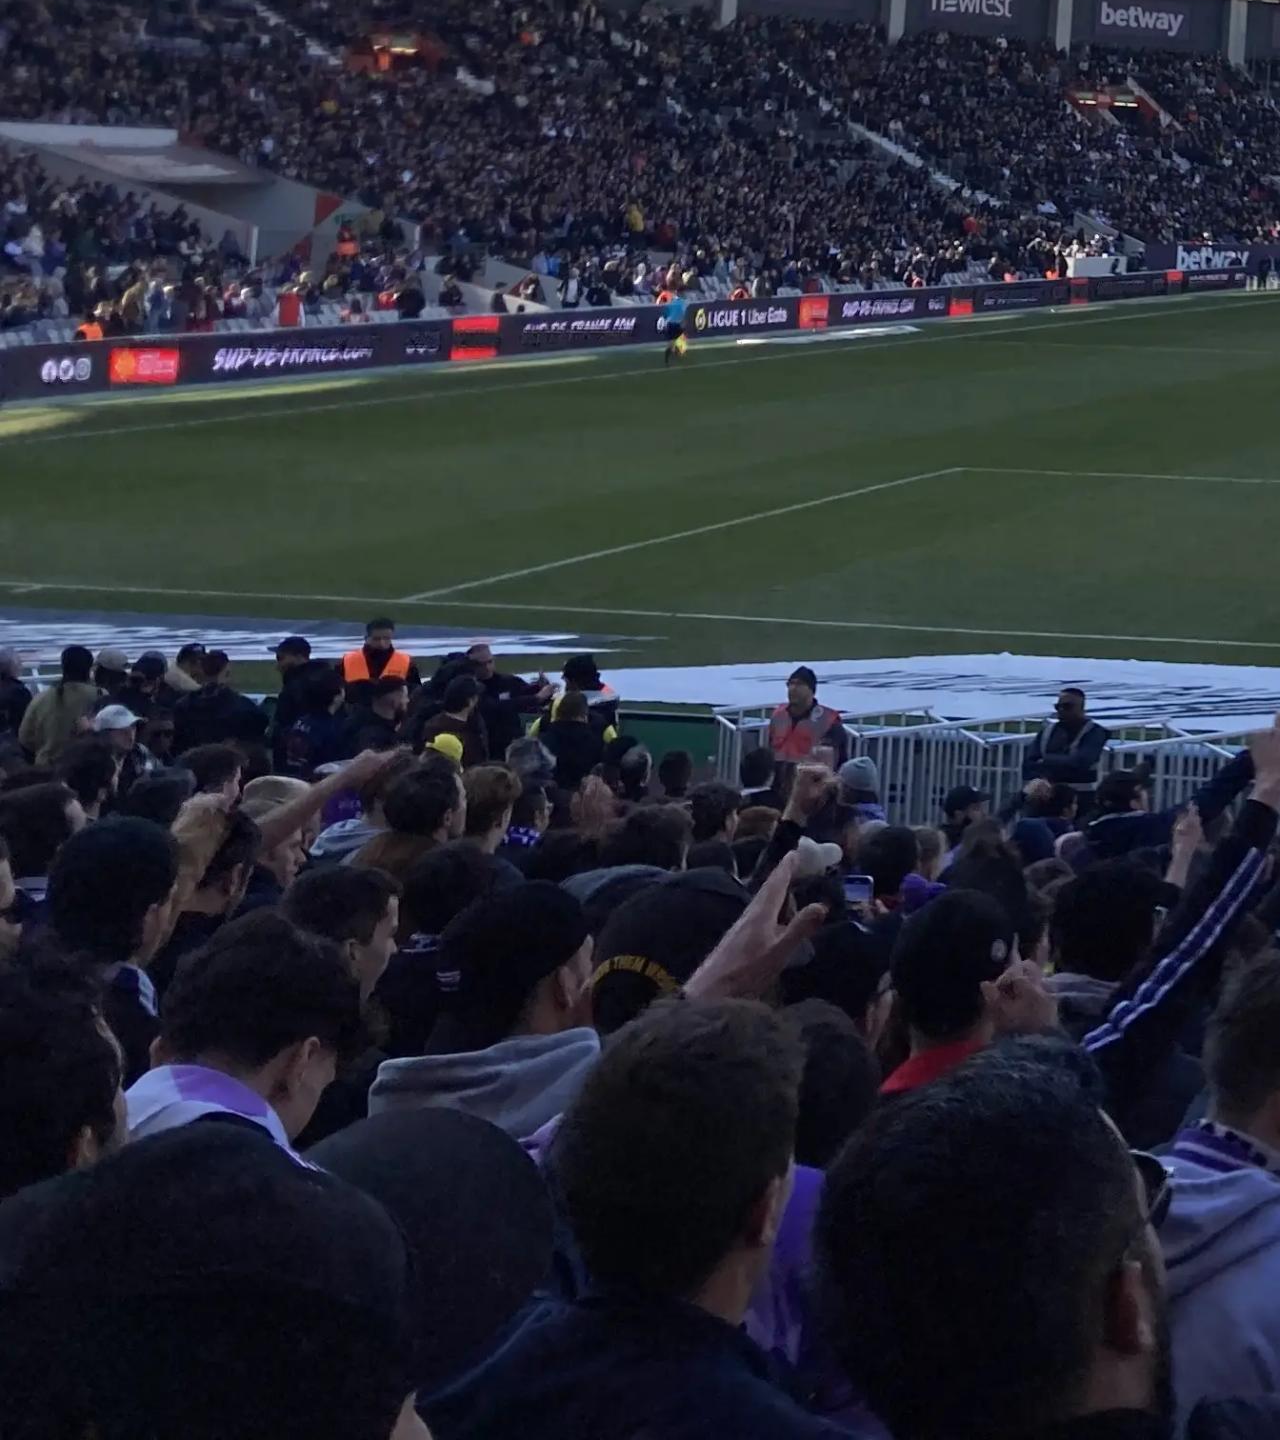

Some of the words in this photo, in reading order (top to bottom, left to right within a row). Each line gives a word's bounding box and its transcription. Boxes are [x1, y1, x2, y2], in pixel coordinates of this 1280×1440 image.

[1100, 1, 1185, 37] betway
[707, 310, 739, 328] LIGUE
[741, 309, 746, 326] 1
[748, 308, 767, 325] Uber
[768, 306, 788, 324] Eats
